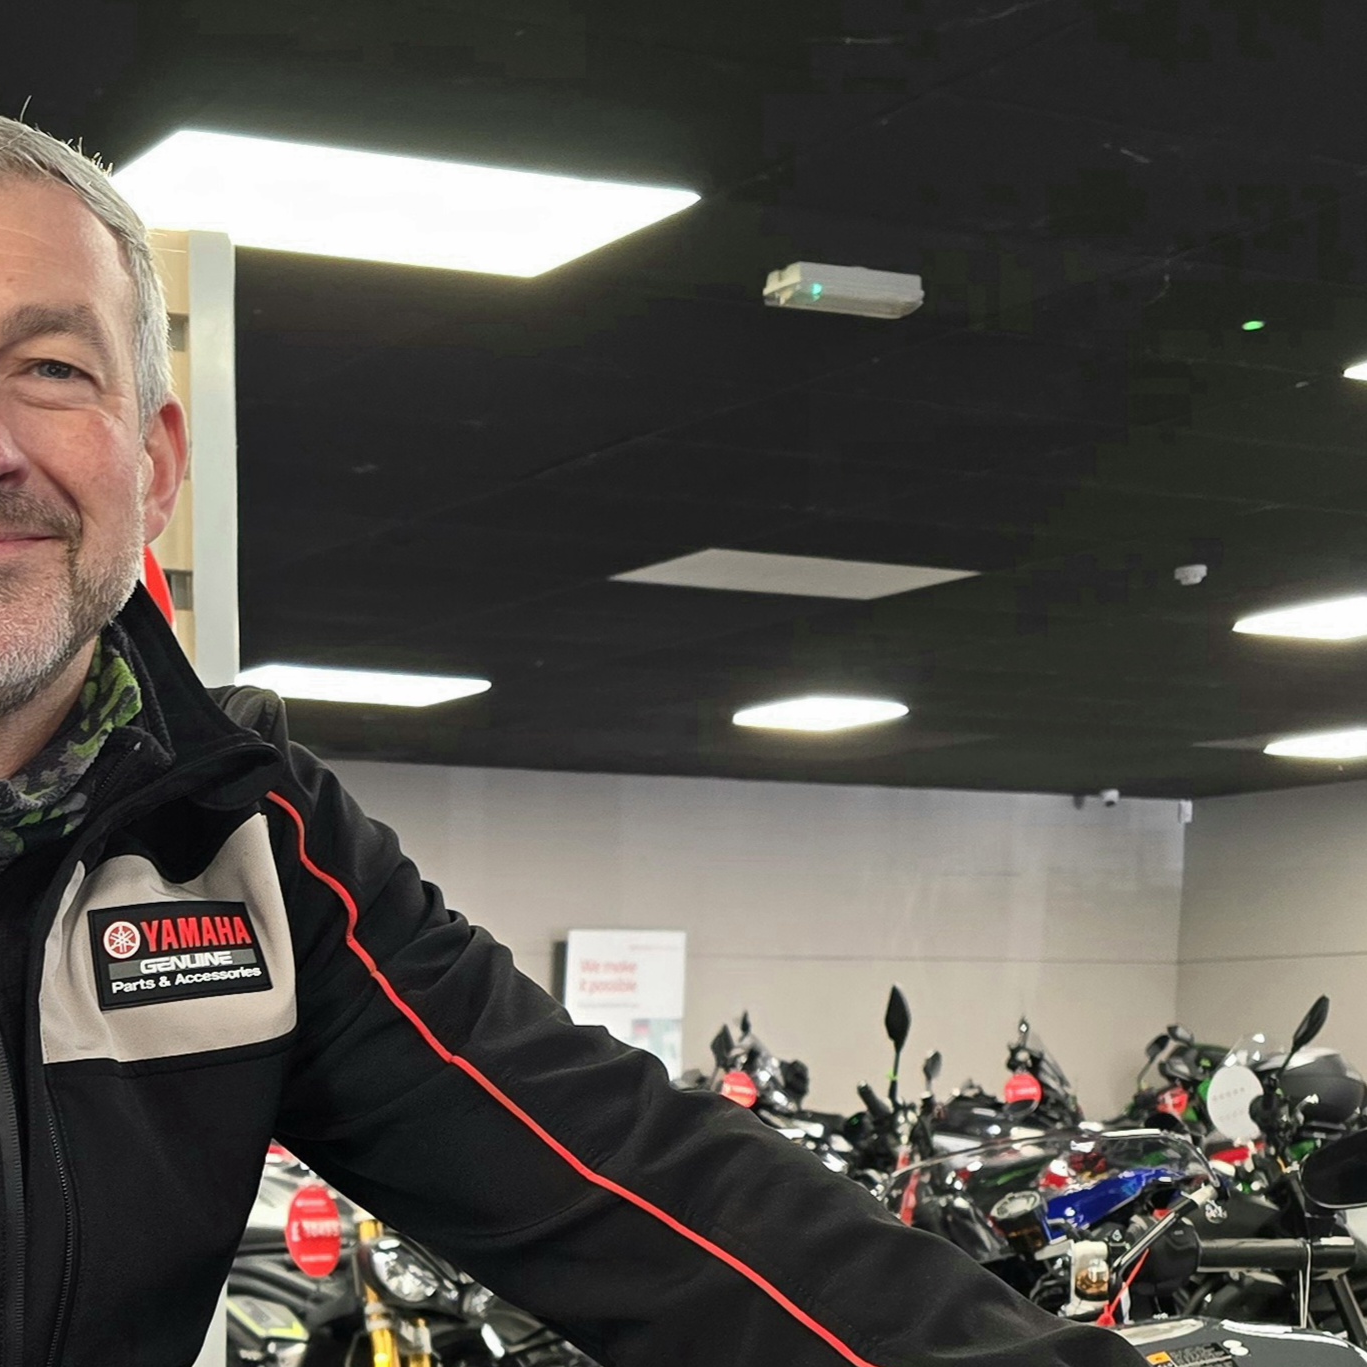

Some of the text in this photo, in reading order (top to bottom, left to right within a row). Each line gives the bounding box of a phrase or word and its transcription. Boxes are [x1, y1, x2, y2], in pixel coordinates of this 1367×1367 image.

[140, 916, 252, 952] YAMAHA
[140, 950, 233, 974] GENUINE
[112, 966, 262, 994] Parts & Accessories
